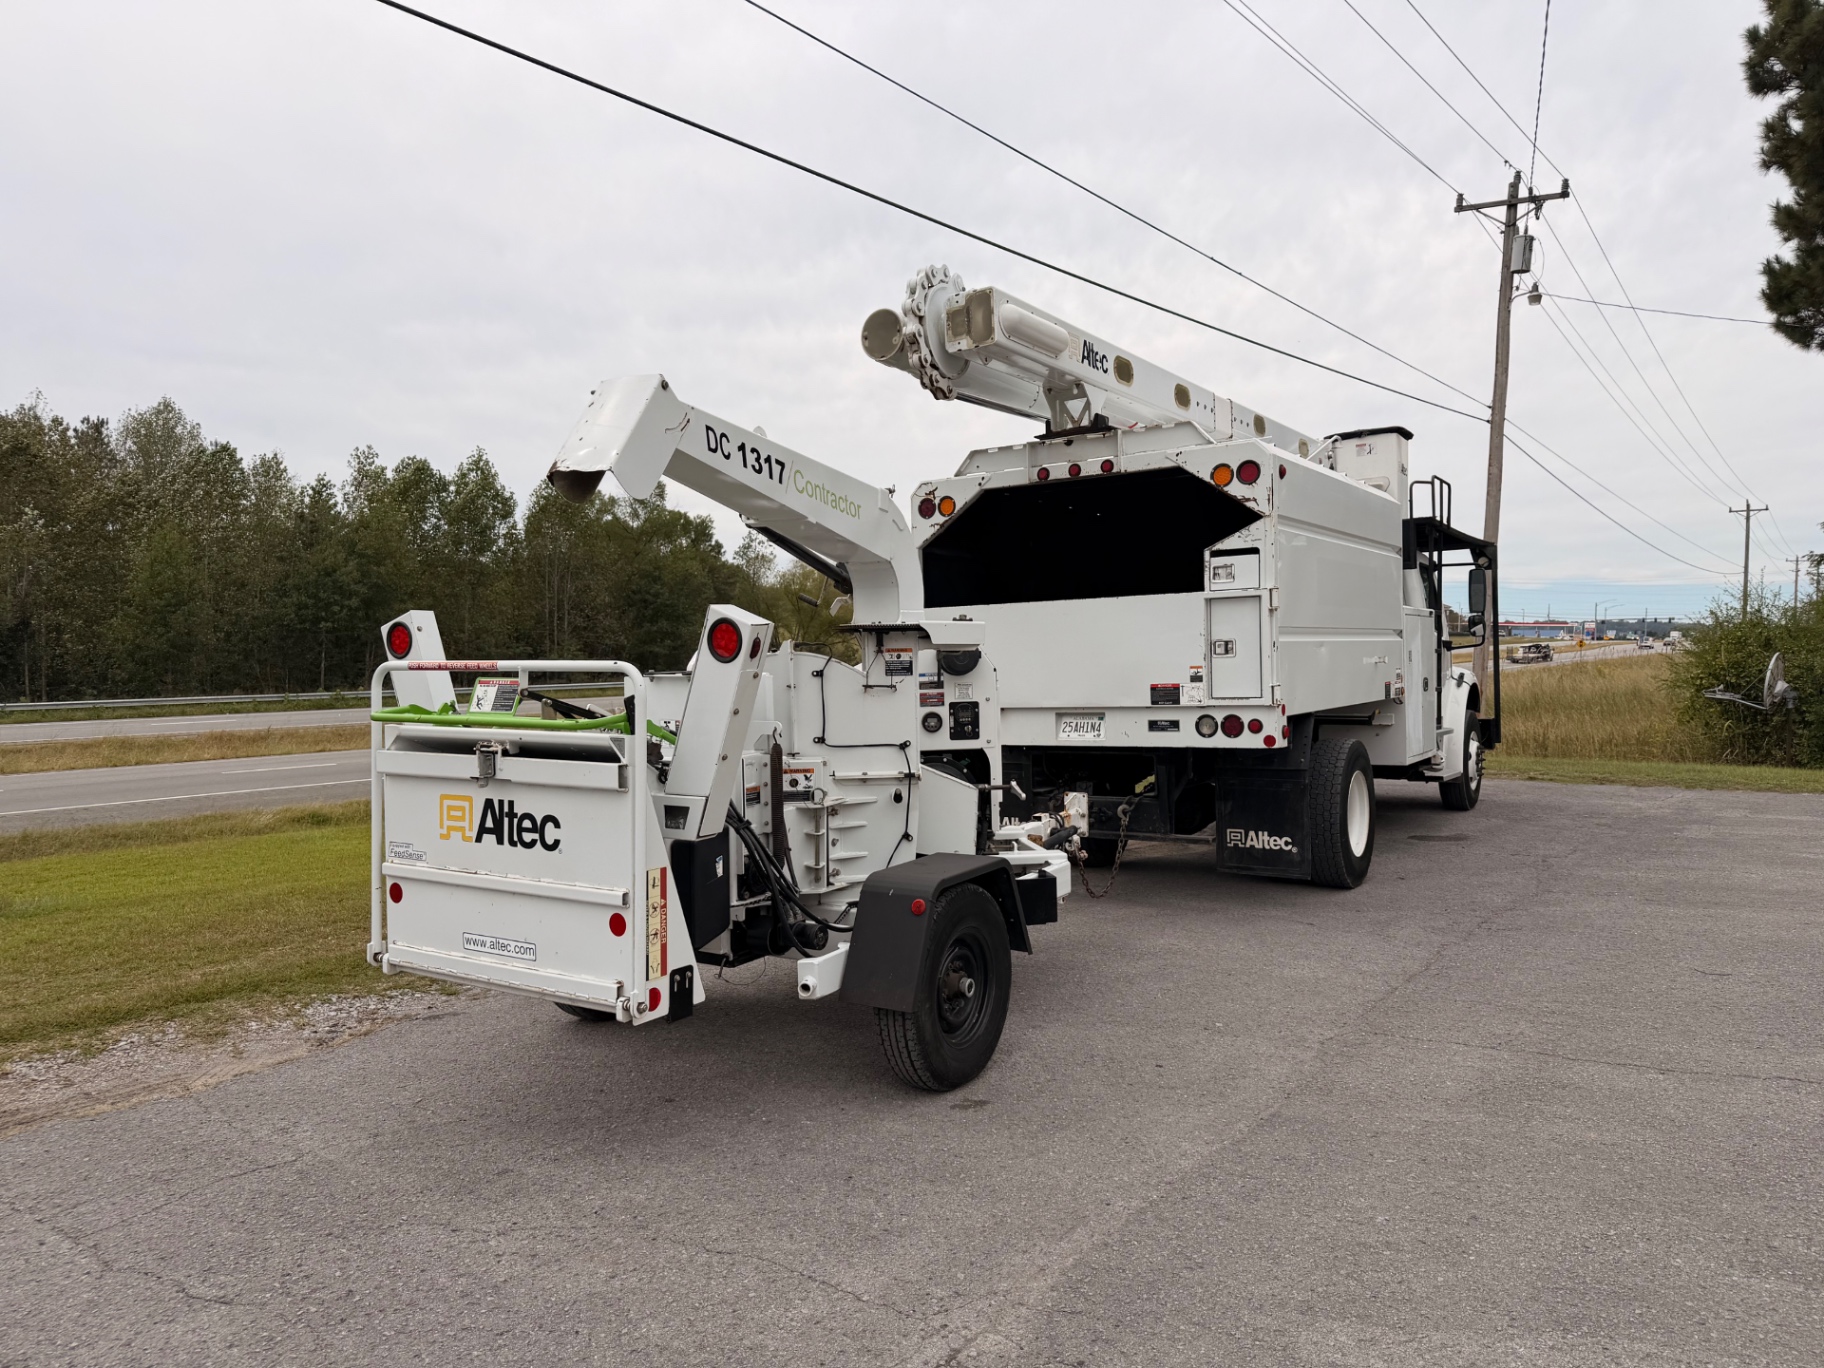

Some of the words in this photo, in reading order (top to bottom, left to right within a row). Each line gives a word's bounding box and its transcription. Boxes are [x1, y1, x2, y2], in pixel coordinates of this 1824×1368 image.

[1081, 339, 1109, 374] Altec
[705, 424, 731, 461] DC
[737, 441, 786, 485] 1317
[793, 469, 862, 520] Contractor
[475, 798, 562, 852] Altec
[391, 848, 424, 860] FeedSense
[1245, 830, 1293, 851] Altec
[465, 936, 535, 957] www.altec.com
